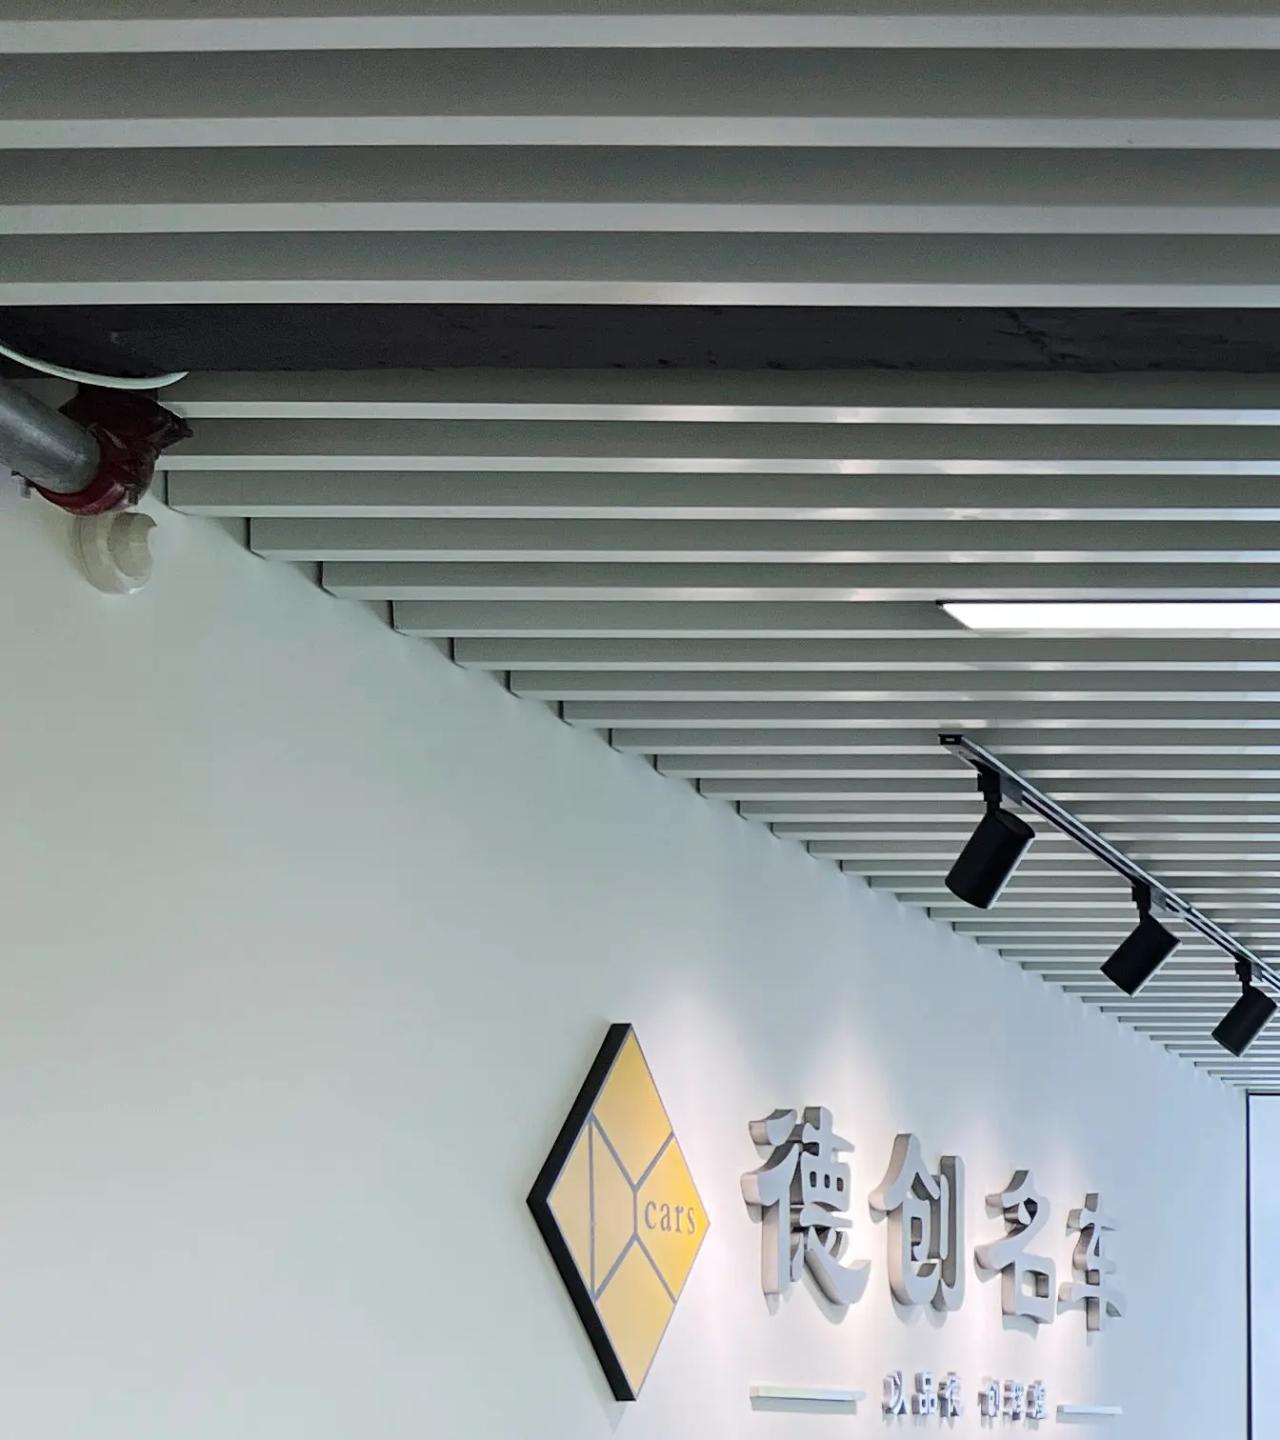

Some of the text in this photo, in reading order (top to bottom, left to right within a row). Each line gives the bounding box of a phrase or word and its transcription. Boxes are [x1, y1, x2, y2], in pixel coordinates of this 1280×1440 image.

[644, 1200, 696, 1235] cars
[740, 1106, 1121, 1331] 德创名车
